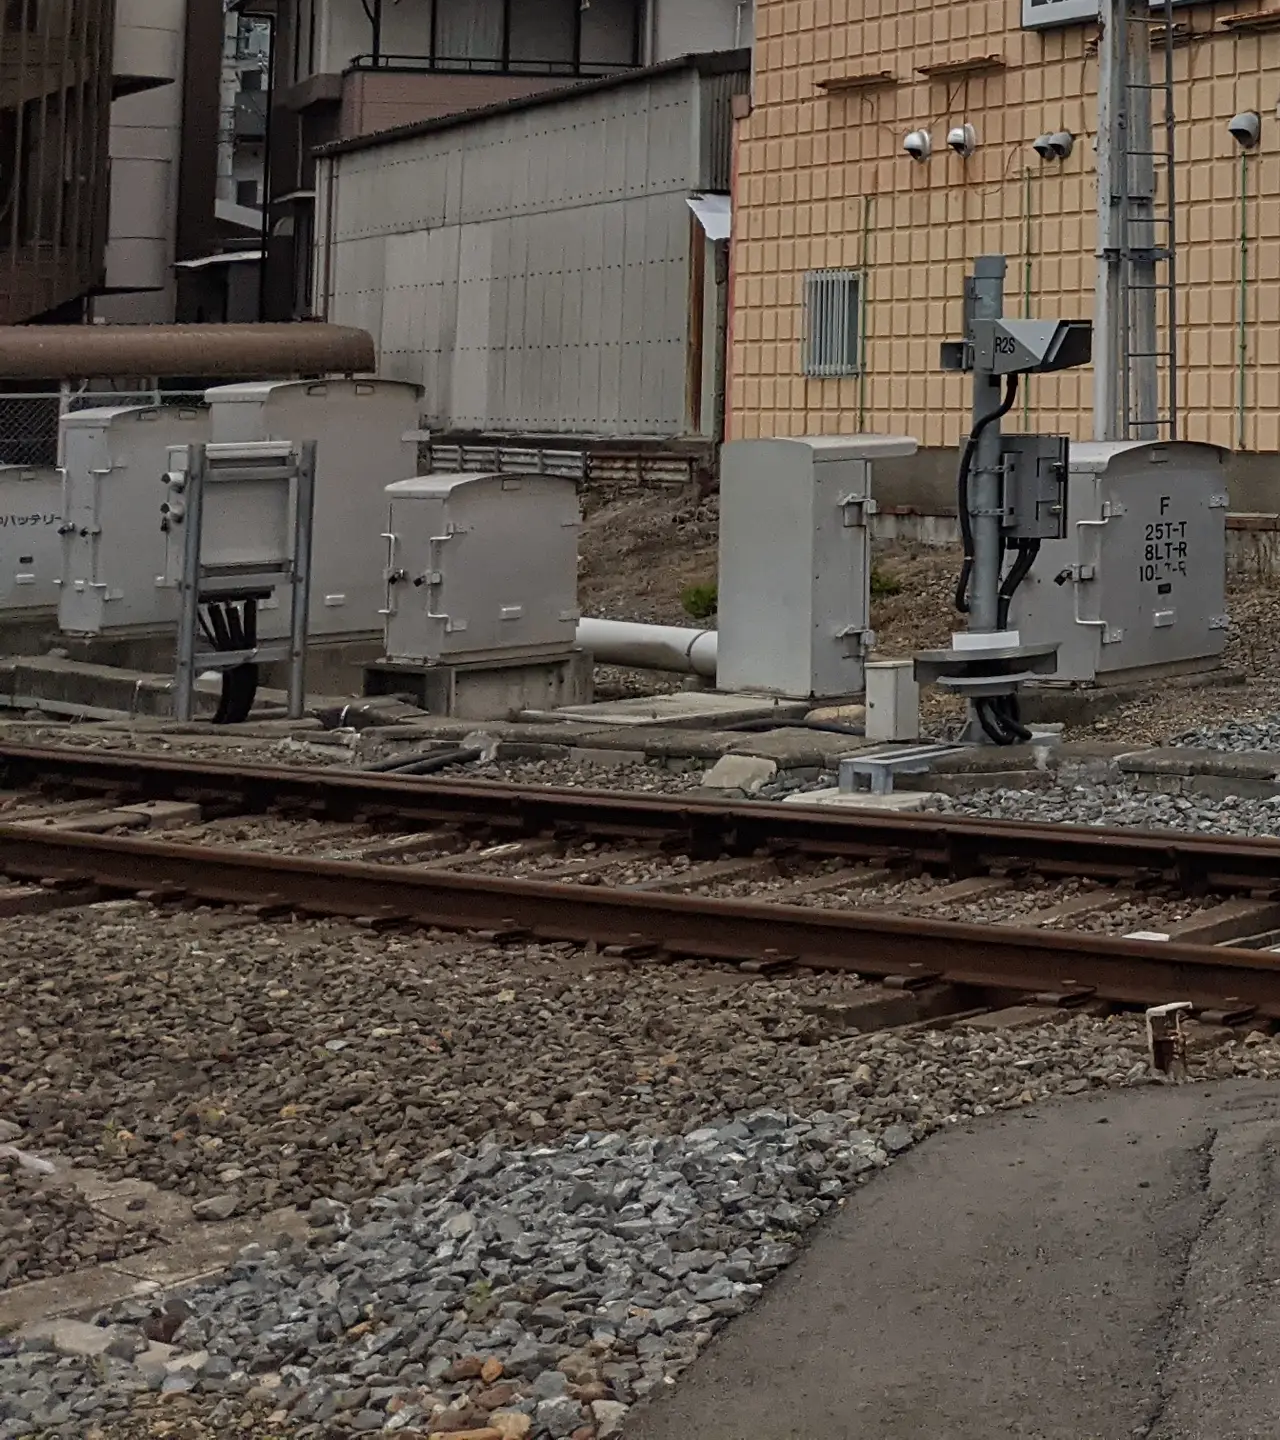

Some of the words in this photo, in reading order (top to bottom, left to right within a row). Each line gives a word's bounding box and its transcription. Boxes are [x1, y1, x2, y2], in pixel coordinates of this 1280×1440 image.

[994, 336, 1015, 354] R2S
[1160, 496, 1171, 516] F
[1145, 521, 1187, 541] 25T-T
[1145, 541, 1187, 561] 8LT-R
